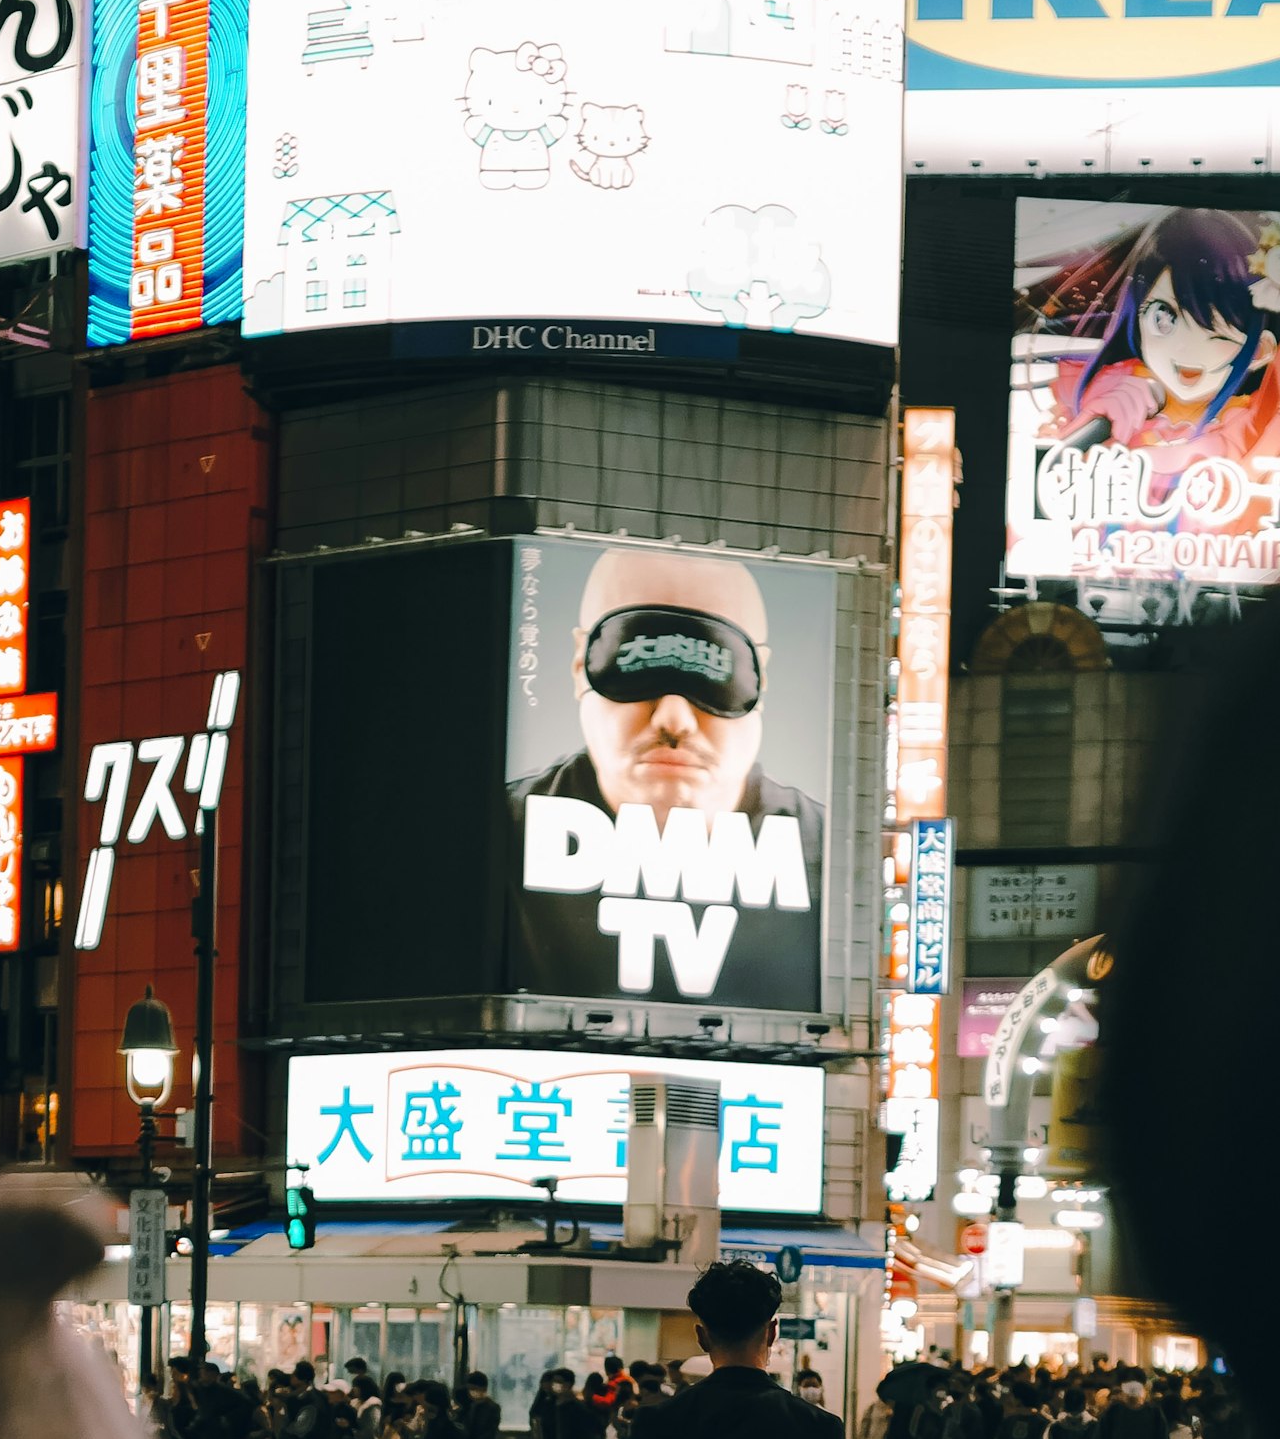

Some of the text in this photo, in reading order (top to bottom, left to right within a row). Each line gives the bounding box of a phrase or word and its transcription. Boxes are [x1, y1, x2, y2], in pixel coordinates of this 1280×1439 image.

[472, 325, 656, 352] DHC Channel
[518, 547, 543, 708] 夢なら覚めて。
[523, 793, 811, 912] DMM
[597, 895, 739, 998] TV
[318, 1079, 785, 1175] 大盛堂店
